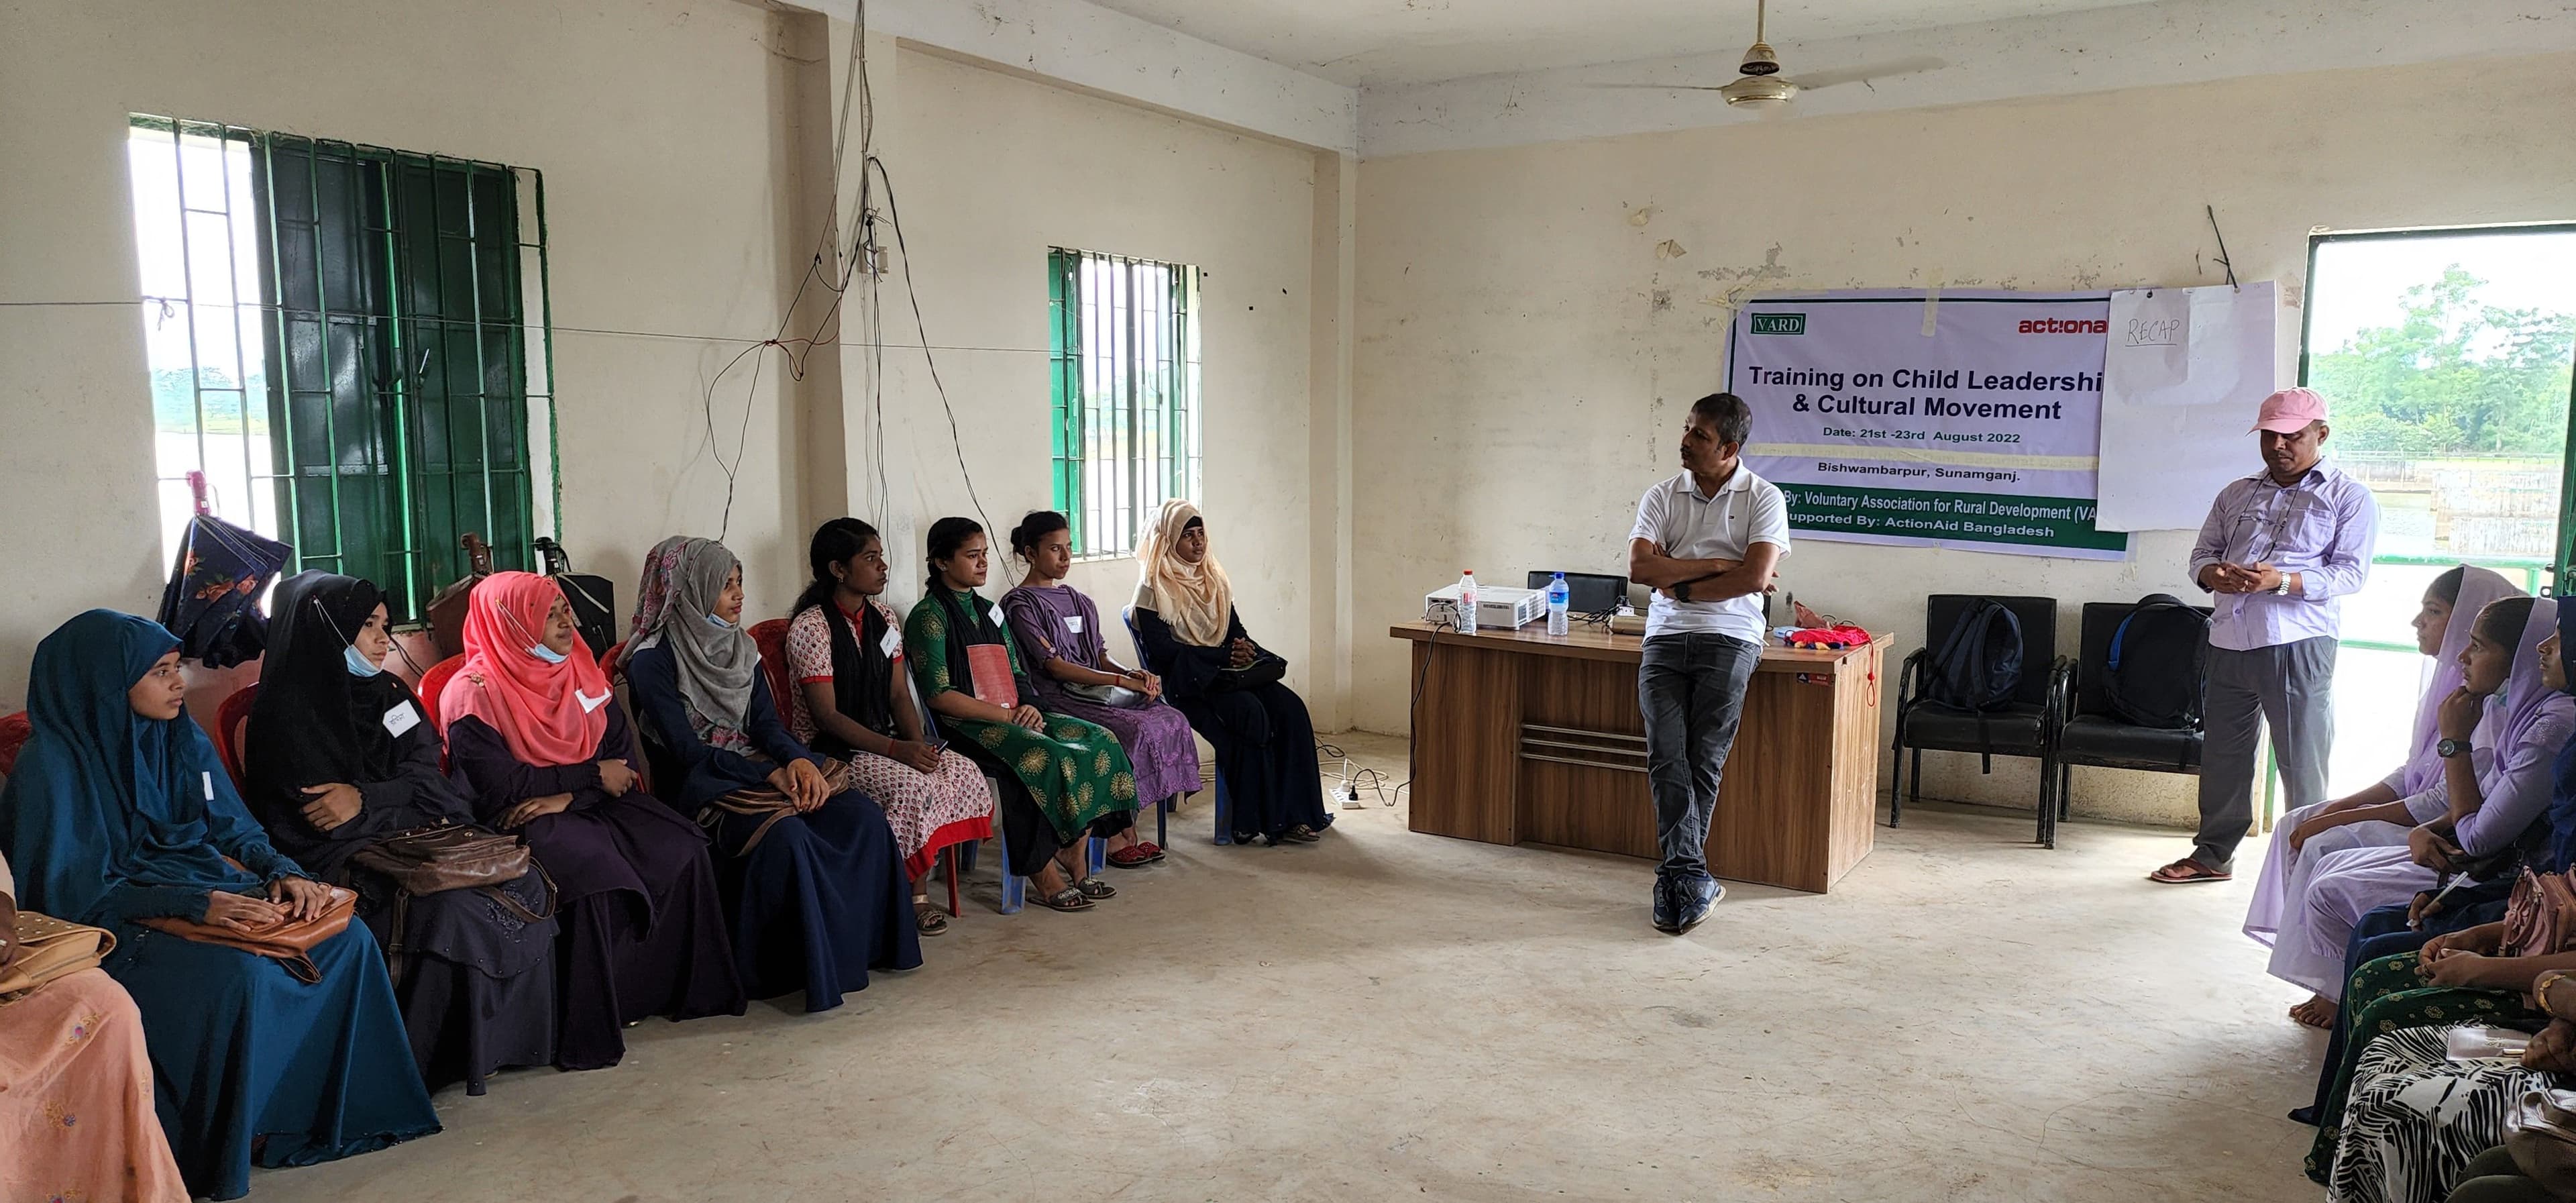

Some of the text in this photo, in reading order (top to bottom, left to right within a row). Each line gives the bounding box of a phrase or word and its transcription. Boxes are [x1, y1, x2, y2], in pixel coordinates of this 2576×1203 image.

[1757, 317, 1799, 331] VARD
[2127, 318, 2180, 344] RECAP
[1749, 366, 2102, 392] Training on Child Leadershi
[1792, 393, 2061, 419] & Cultural Movement
[1823, 427, 2021, 443] Date: 21st -23rd August 2022
[1818, 462, 2021, 483] Bishwambarpur, Sunamganj.
[1784, 490, 2096, 524] By: Voluntary Association for Rural Development (VA
[1789, 513, 2054, 537] upported By: ActionAid Bangladesh
